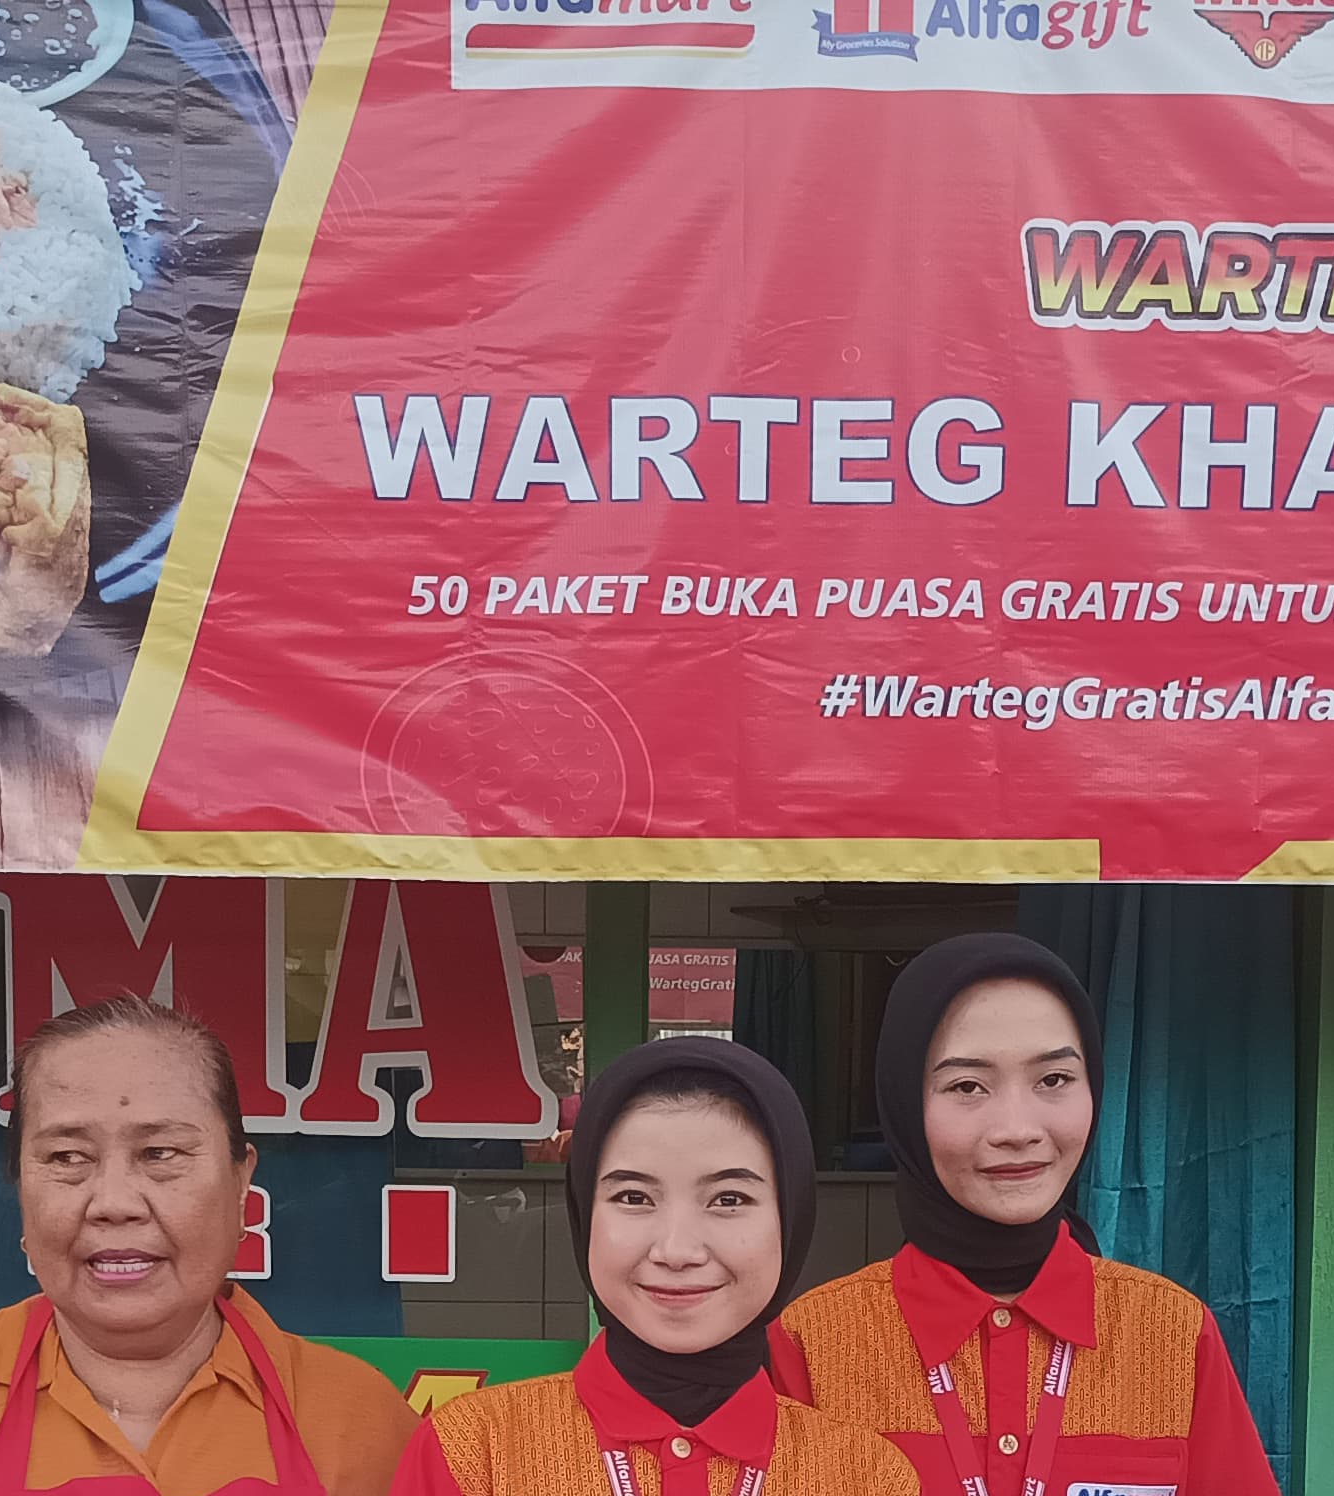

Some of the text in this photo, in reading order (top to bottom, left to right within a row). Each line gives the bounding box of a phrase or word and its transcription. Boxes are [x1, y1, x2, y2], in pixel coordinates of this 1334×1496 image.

[925, 0, 1150, 50] Alfagift
[353, 394, 1006, 506] WARTEG
[407, 576, 468, 616] 50
[484, 576, 647, 615] PAKET
[661, 576, 798, 617] BUKA
[816, 578, 985, 620] PUASA
[1001, 579, 1181, 622] GRATIS
[684, 954, 729, 966] GRATIS
[1044, 1340, 1065, 1396] Alfamar
